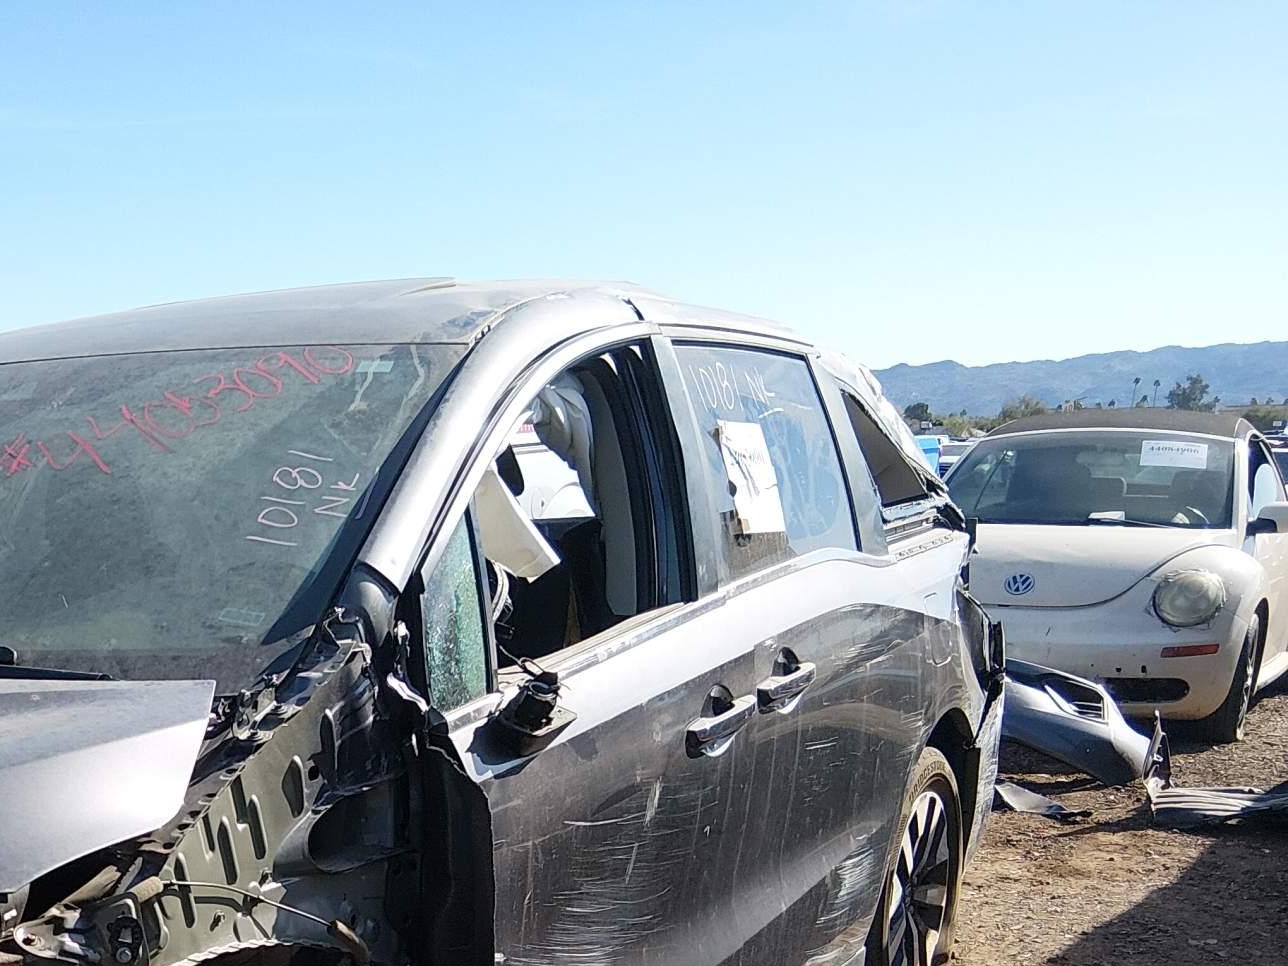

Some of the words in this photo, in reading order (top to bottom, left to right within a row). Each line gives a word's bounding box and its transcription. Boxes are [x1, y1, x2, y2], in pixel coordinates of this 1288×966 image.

[688, 361, 745, 413] 10181
[245, 449, 334, 546] 10181
[313, 472, 360, 518] NK
